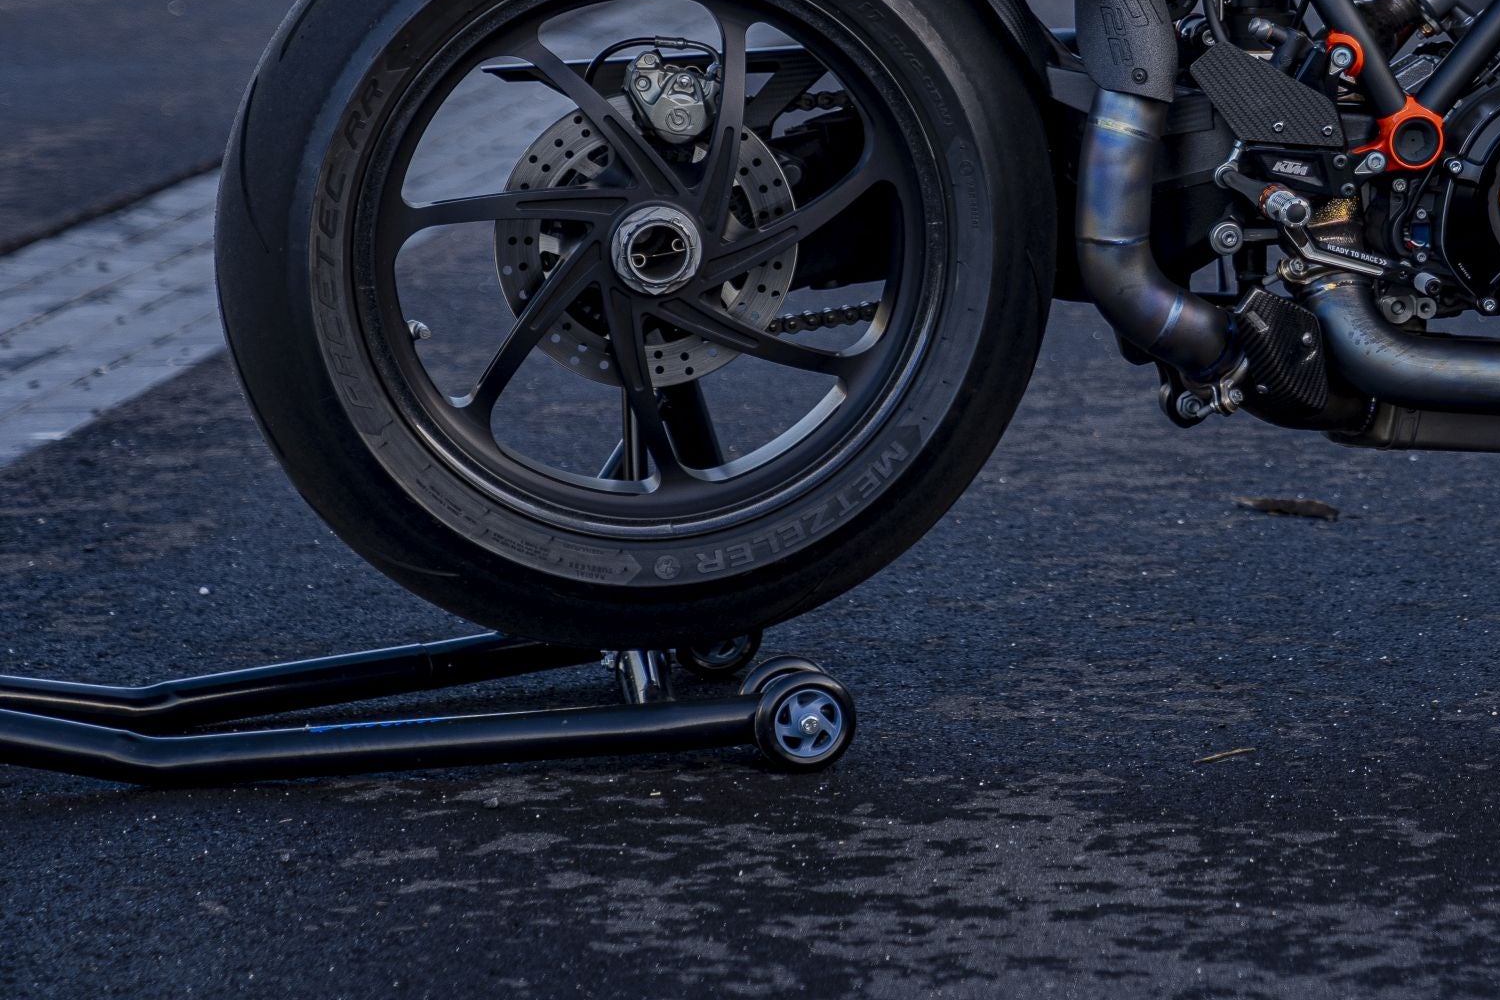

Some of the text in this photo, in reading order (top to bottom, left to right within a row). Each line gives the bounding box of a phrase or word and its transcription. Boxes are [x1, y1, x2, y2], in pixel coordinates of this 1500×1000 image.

[345, 78, 383, 149] RR
[1271, 160, 1309, 176] KTM
[1327, 244, 1379, 264] READY TO RACE
[696, 441, 909, 574] METZELER
